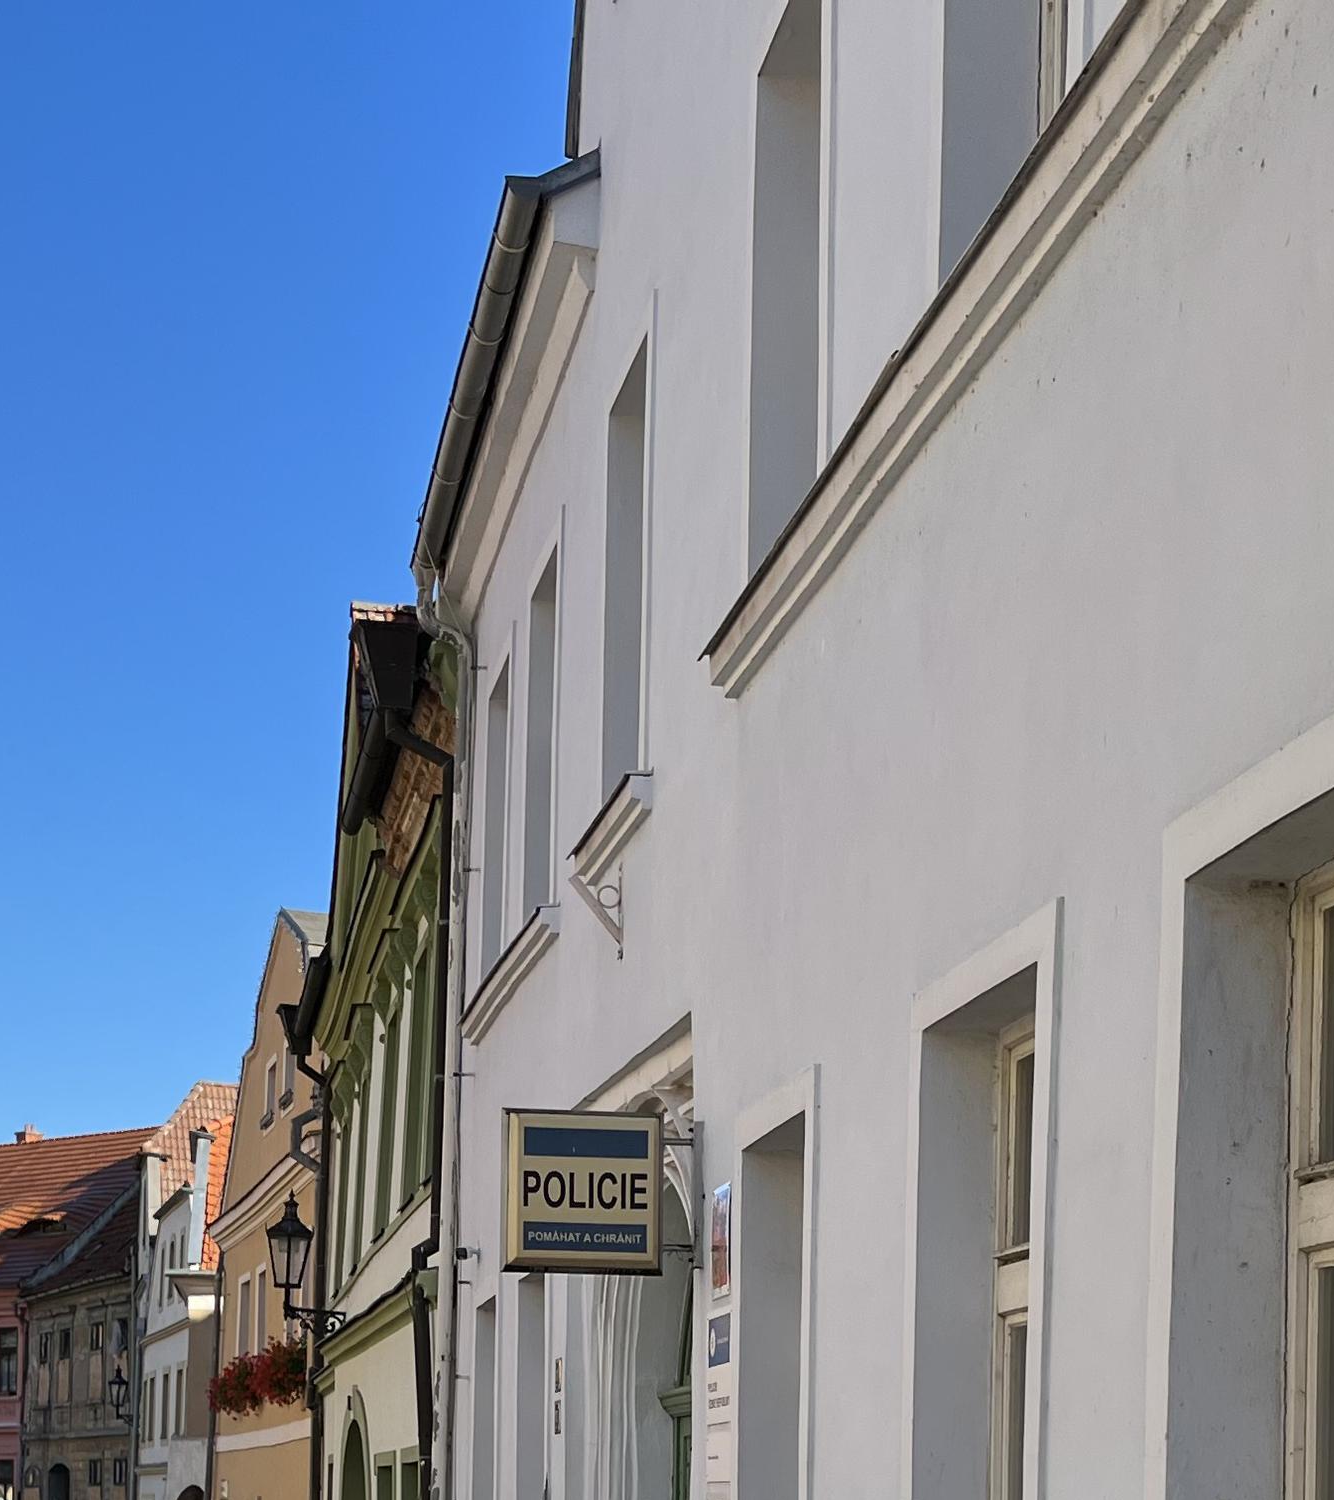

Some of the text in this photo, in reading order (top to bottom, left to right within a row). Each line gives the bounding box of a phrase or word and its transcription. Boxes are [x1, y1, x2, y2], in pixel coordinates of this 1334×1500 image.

[523, 1170, 648, 1209] POLICIE
[527, 1230, 642, 1244] POMÁHAT A CHRÁNIT
